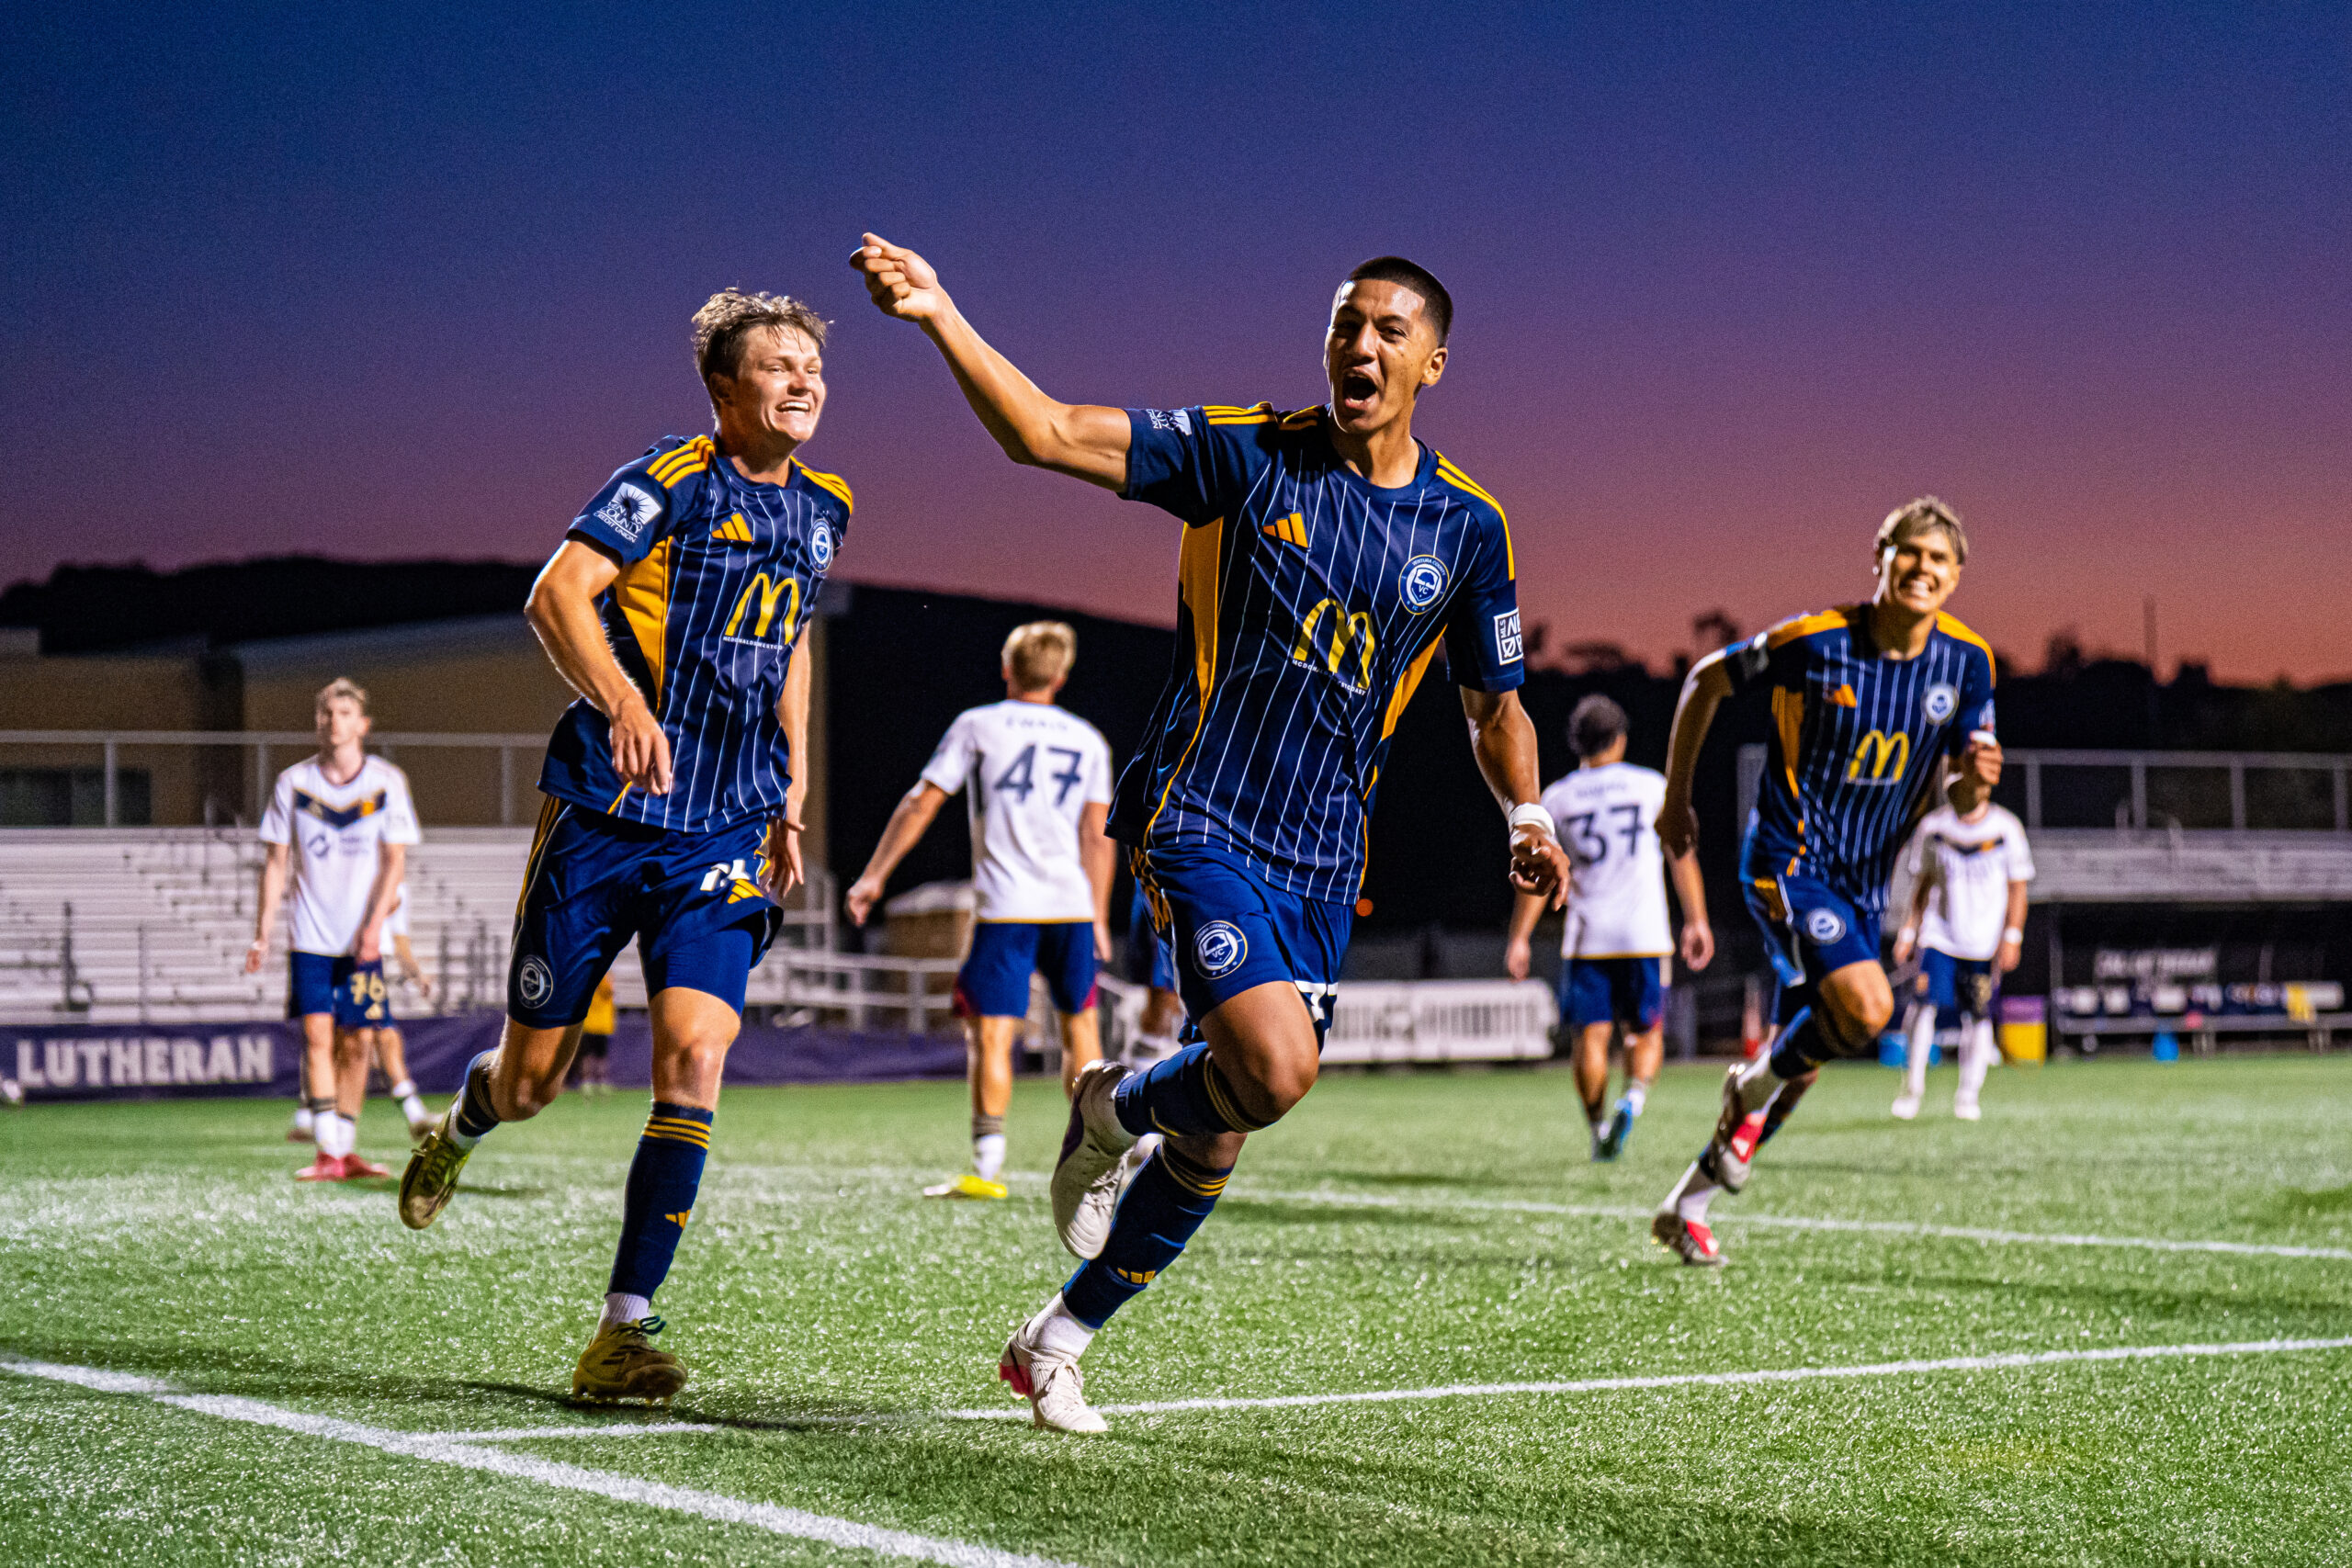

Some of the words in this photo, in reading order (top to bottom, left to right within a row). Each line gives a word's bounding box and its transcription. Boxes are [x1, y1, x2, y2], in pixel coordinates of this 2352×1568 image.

[615, 525, 637, 543] UNION
[1419, 584, 1429, 595] VC
[993, 743, 1082, 807] 47
[1565, 802, 1645, 864] 37
[1212, 948, 1225, 958] VC
[350, 971, 386, 1005] 76
[17, 1034, 273, 1088] LUTHERAN
